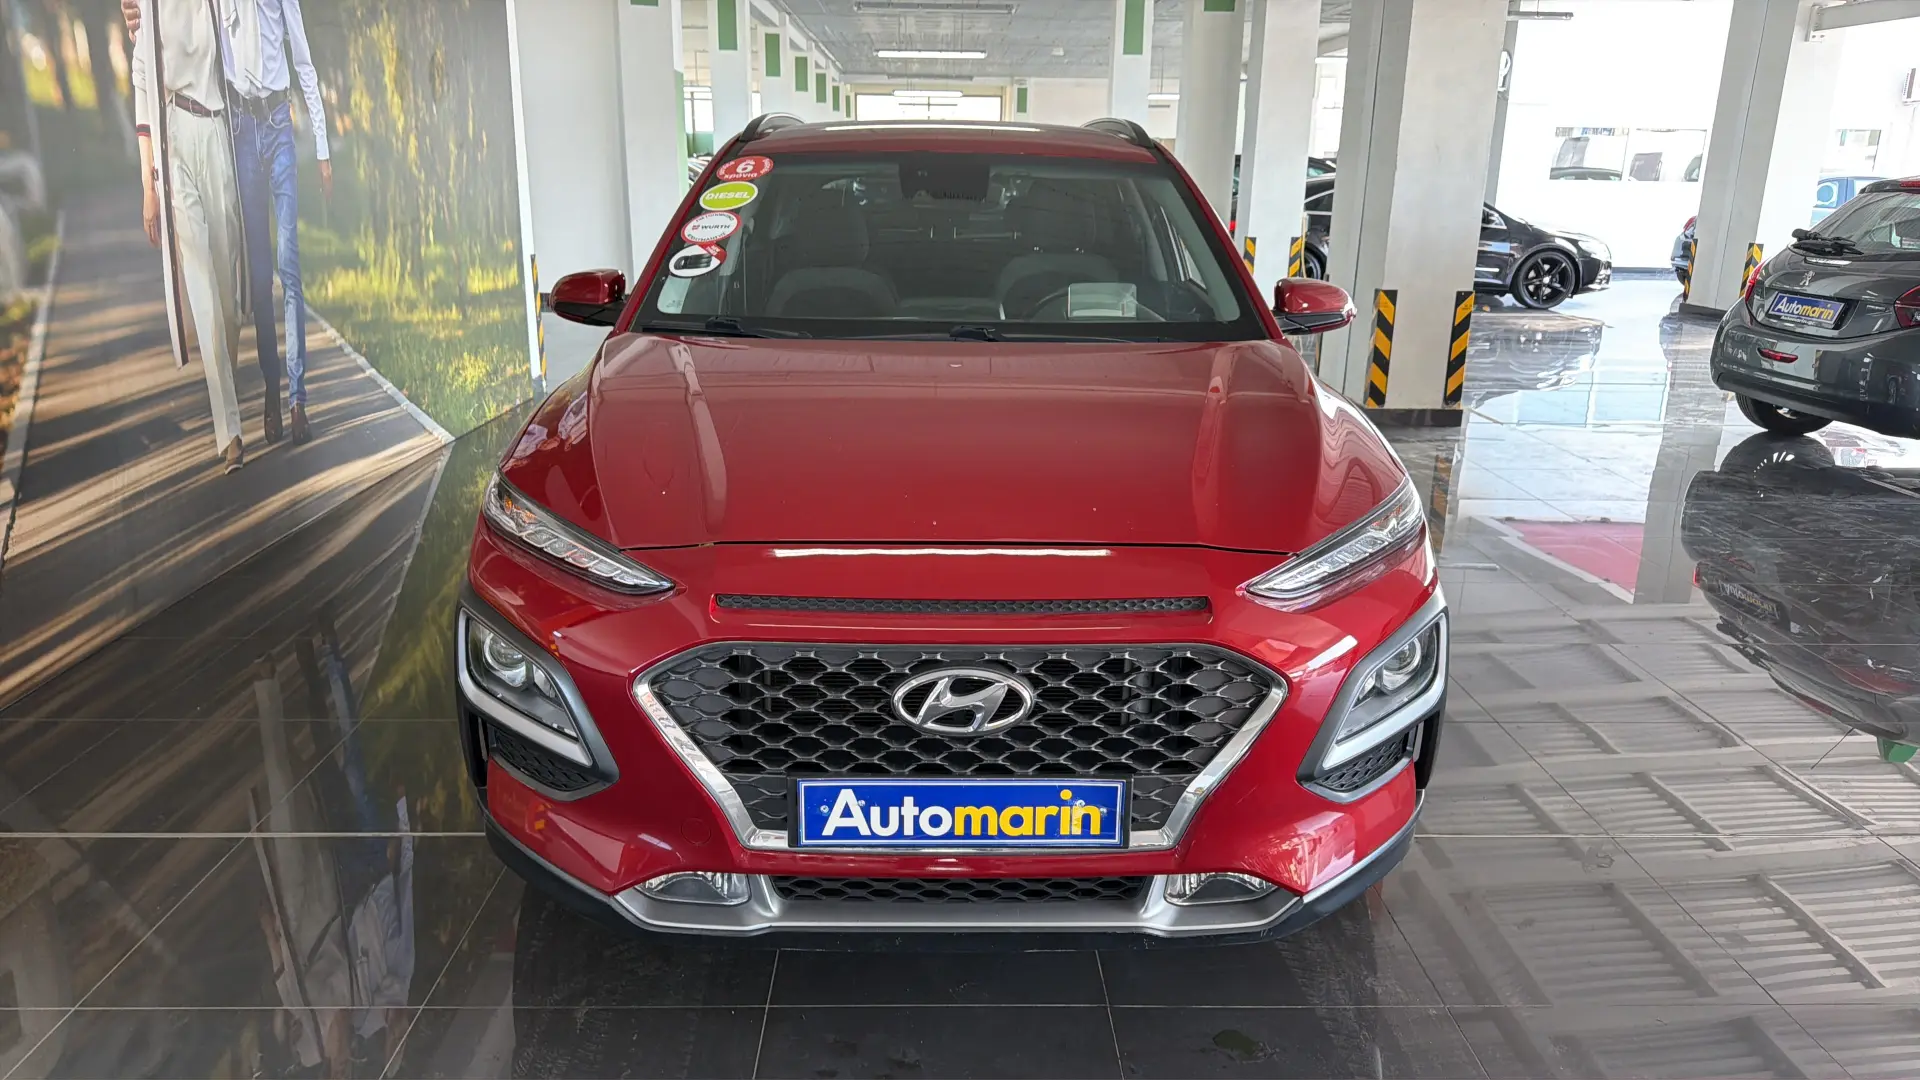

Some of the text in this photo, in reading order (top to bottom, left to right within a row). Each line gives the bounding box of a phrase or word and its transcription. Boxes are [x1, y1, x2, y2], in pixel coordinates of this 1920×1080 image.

[736, 160, 756, 174] 6
[705, 191, 750, 200] DIESEL
[1775, 297, 1834, 320] Automarin
[821, 788, 1101, 837] Automarin
